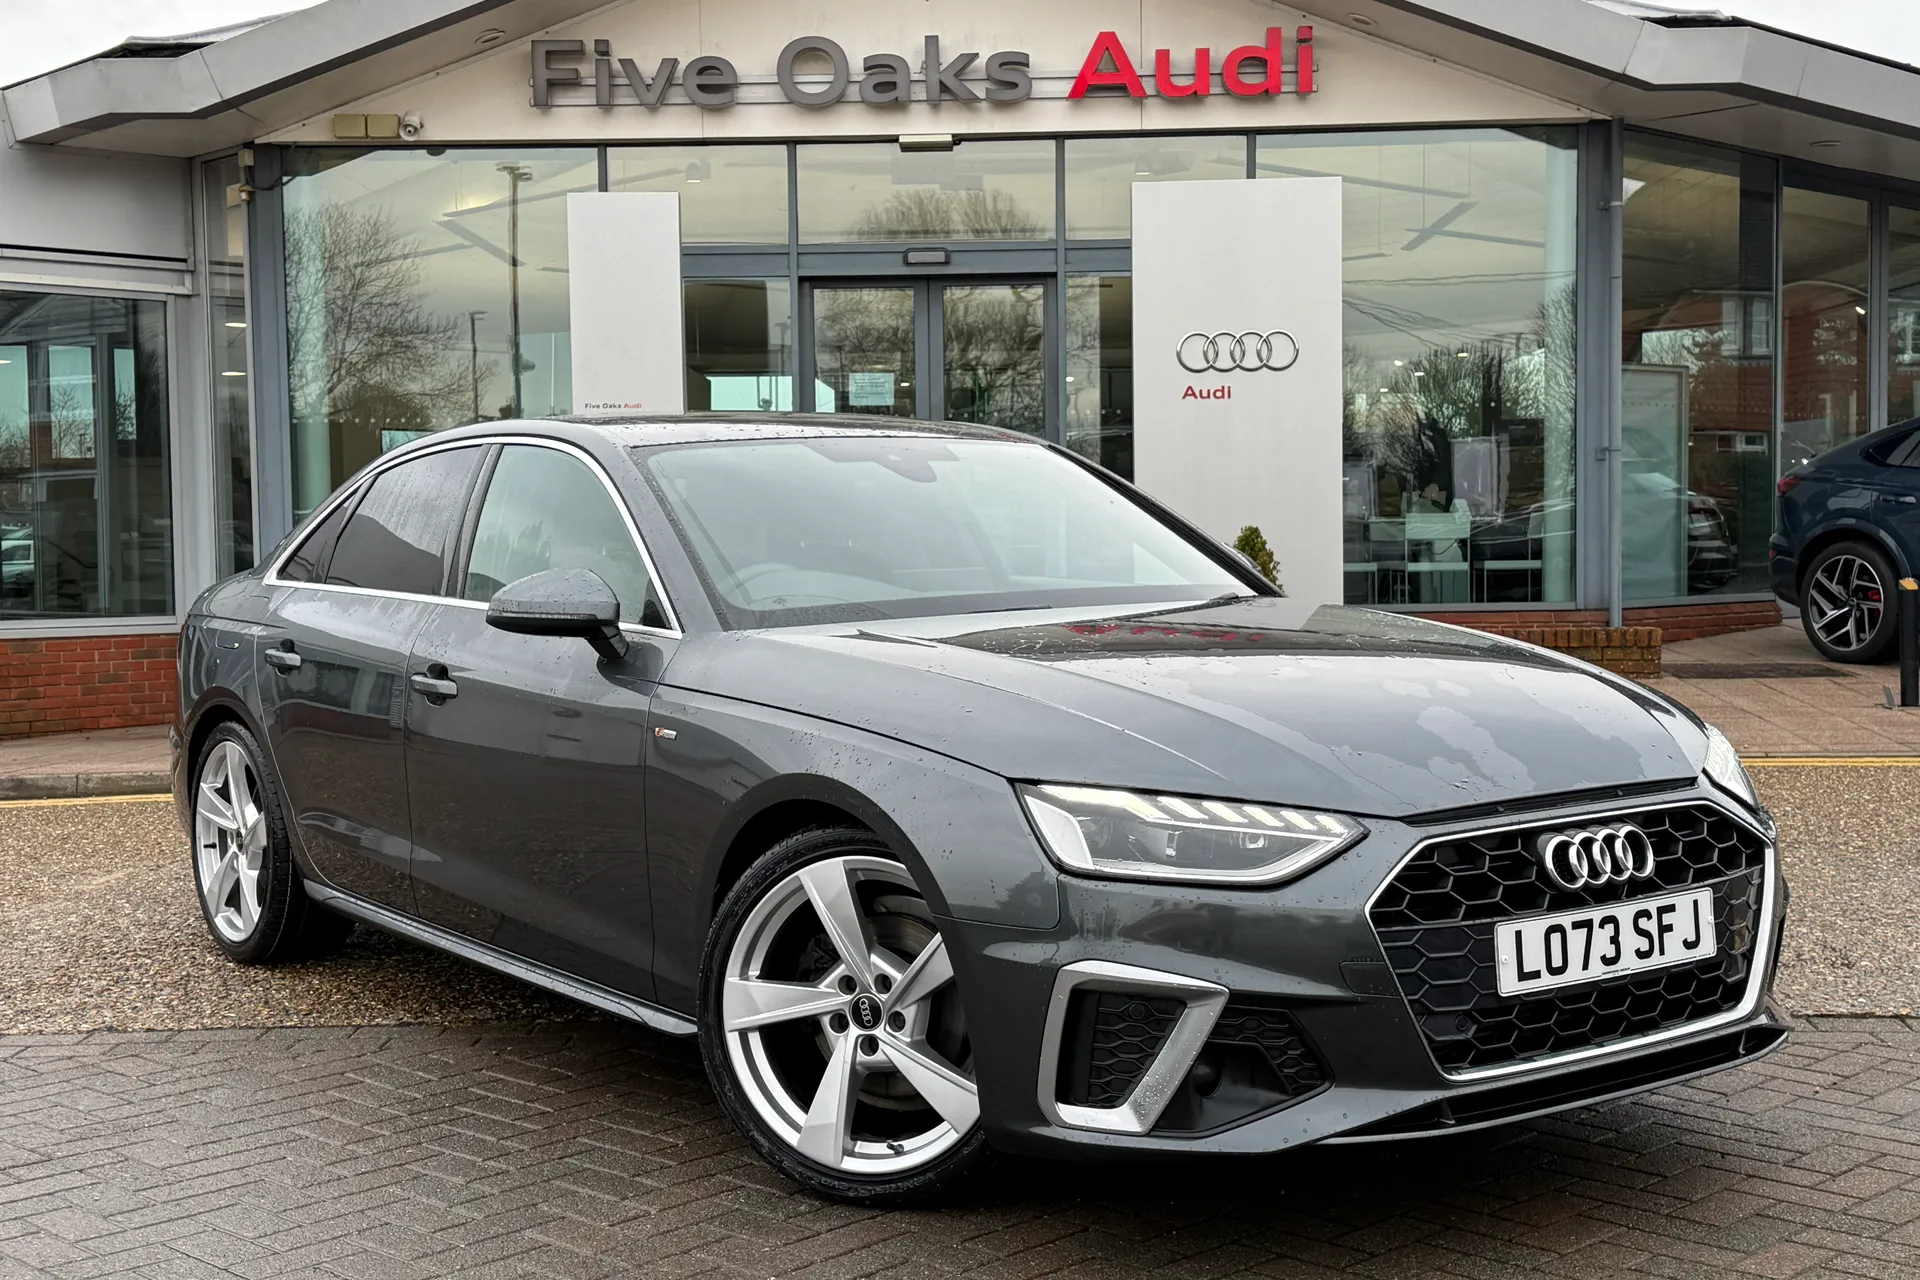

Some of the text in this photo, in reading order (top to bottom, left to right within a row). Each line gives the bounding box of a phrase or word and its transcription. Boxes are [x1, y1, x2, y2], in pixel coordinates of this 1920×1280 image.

[531, 25, 1313, 109] Five Oaks Audi
[1182, 385, 1231, 400] Audi
[1515, 899, 1701, 982] LO73 SFJ
